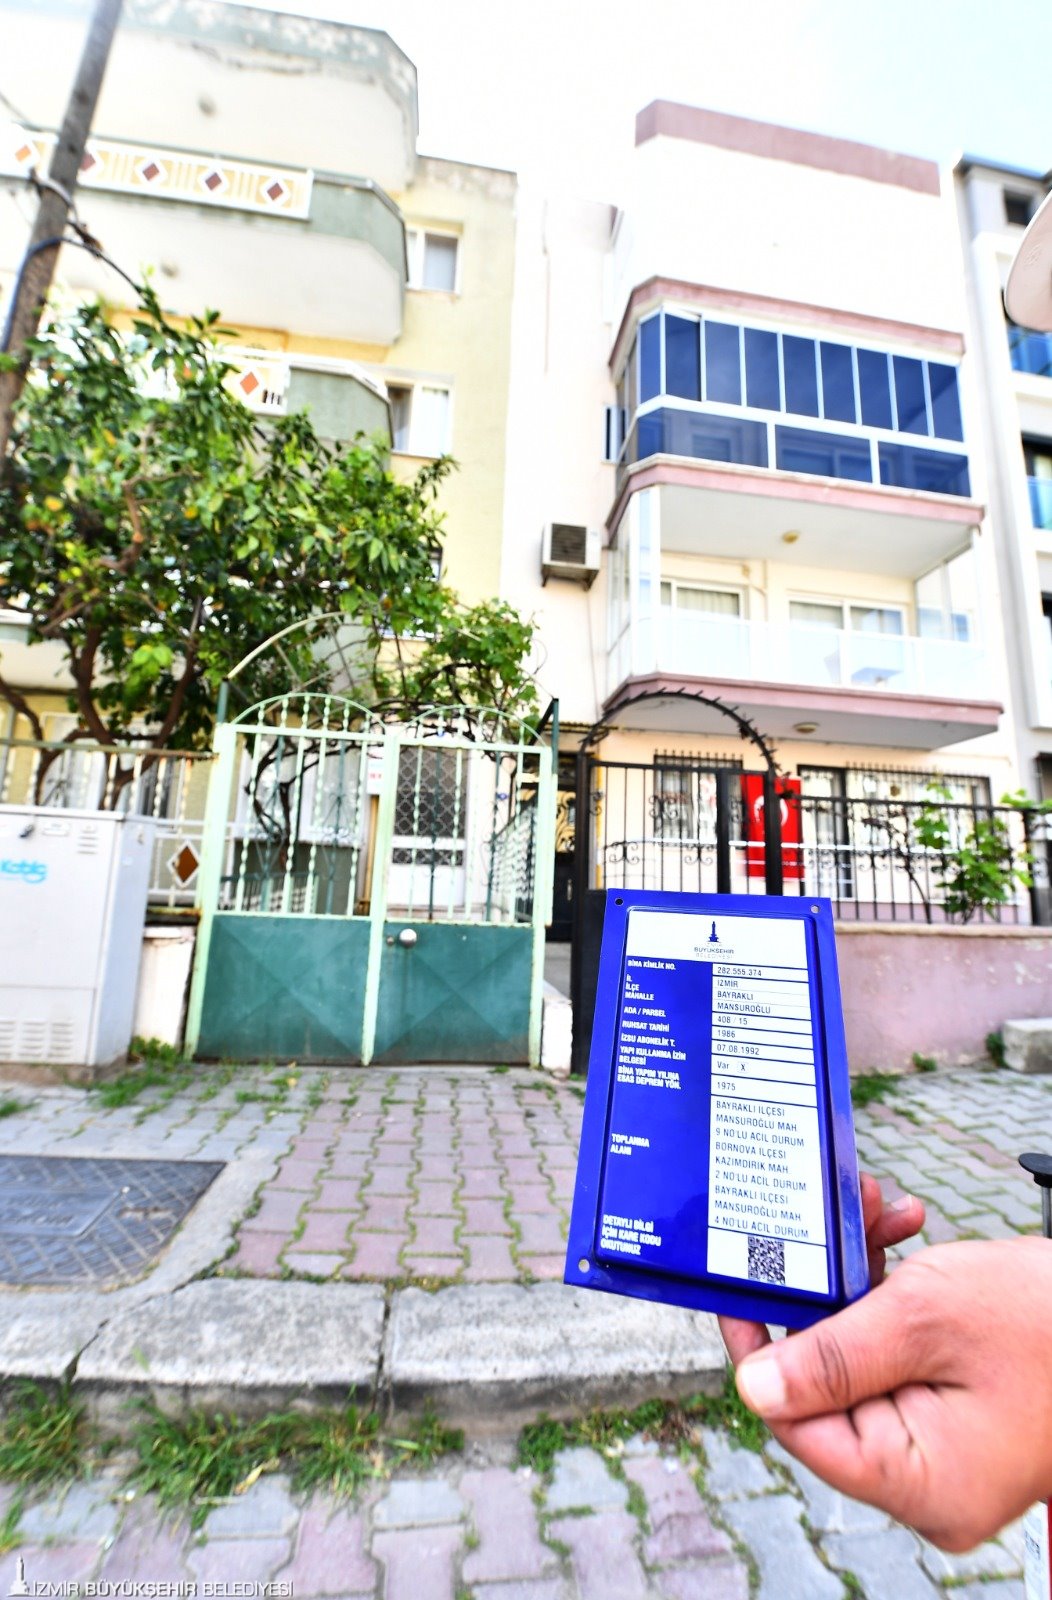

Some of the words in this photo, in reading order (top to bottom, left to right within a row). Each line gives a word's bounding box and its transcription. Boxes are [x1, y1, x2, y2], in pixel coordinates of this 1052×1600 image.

[717, 966, 762, 977] 282.555.374
[717, 990, 754, 1000] BAYRAKLI
[624, 1006, 637, 1014] ADA
[642, 1008, 666, 1018] PARSEL
[717, 1002, 771, 1014] MANSUROĞLU
[717, 1016, 732, 1024] 408
[739, 1017, 748, 1026] 15
[717, 1030, 736, 1038] 1986
[716, 1044, 760, 1056] 07.08.1992
[716, 1060, 730, 1070] Var
[717, 1082, 736, 1092] 1975
[716, 1100, 756, 1113] BAYRAKLI
[716, 1128, 720, 1136] 9
[772, 1134, 805, 1148] DURUM
[716, 1141, 756, 1156] BORNOVA
[716, 1170, 720, 1179] 2
[773, 1178, 808, 1192] DURUM
[715, 1184, 758, 1200] BAYRAKLI
[774, 1224, 810, 1238] DURUM
